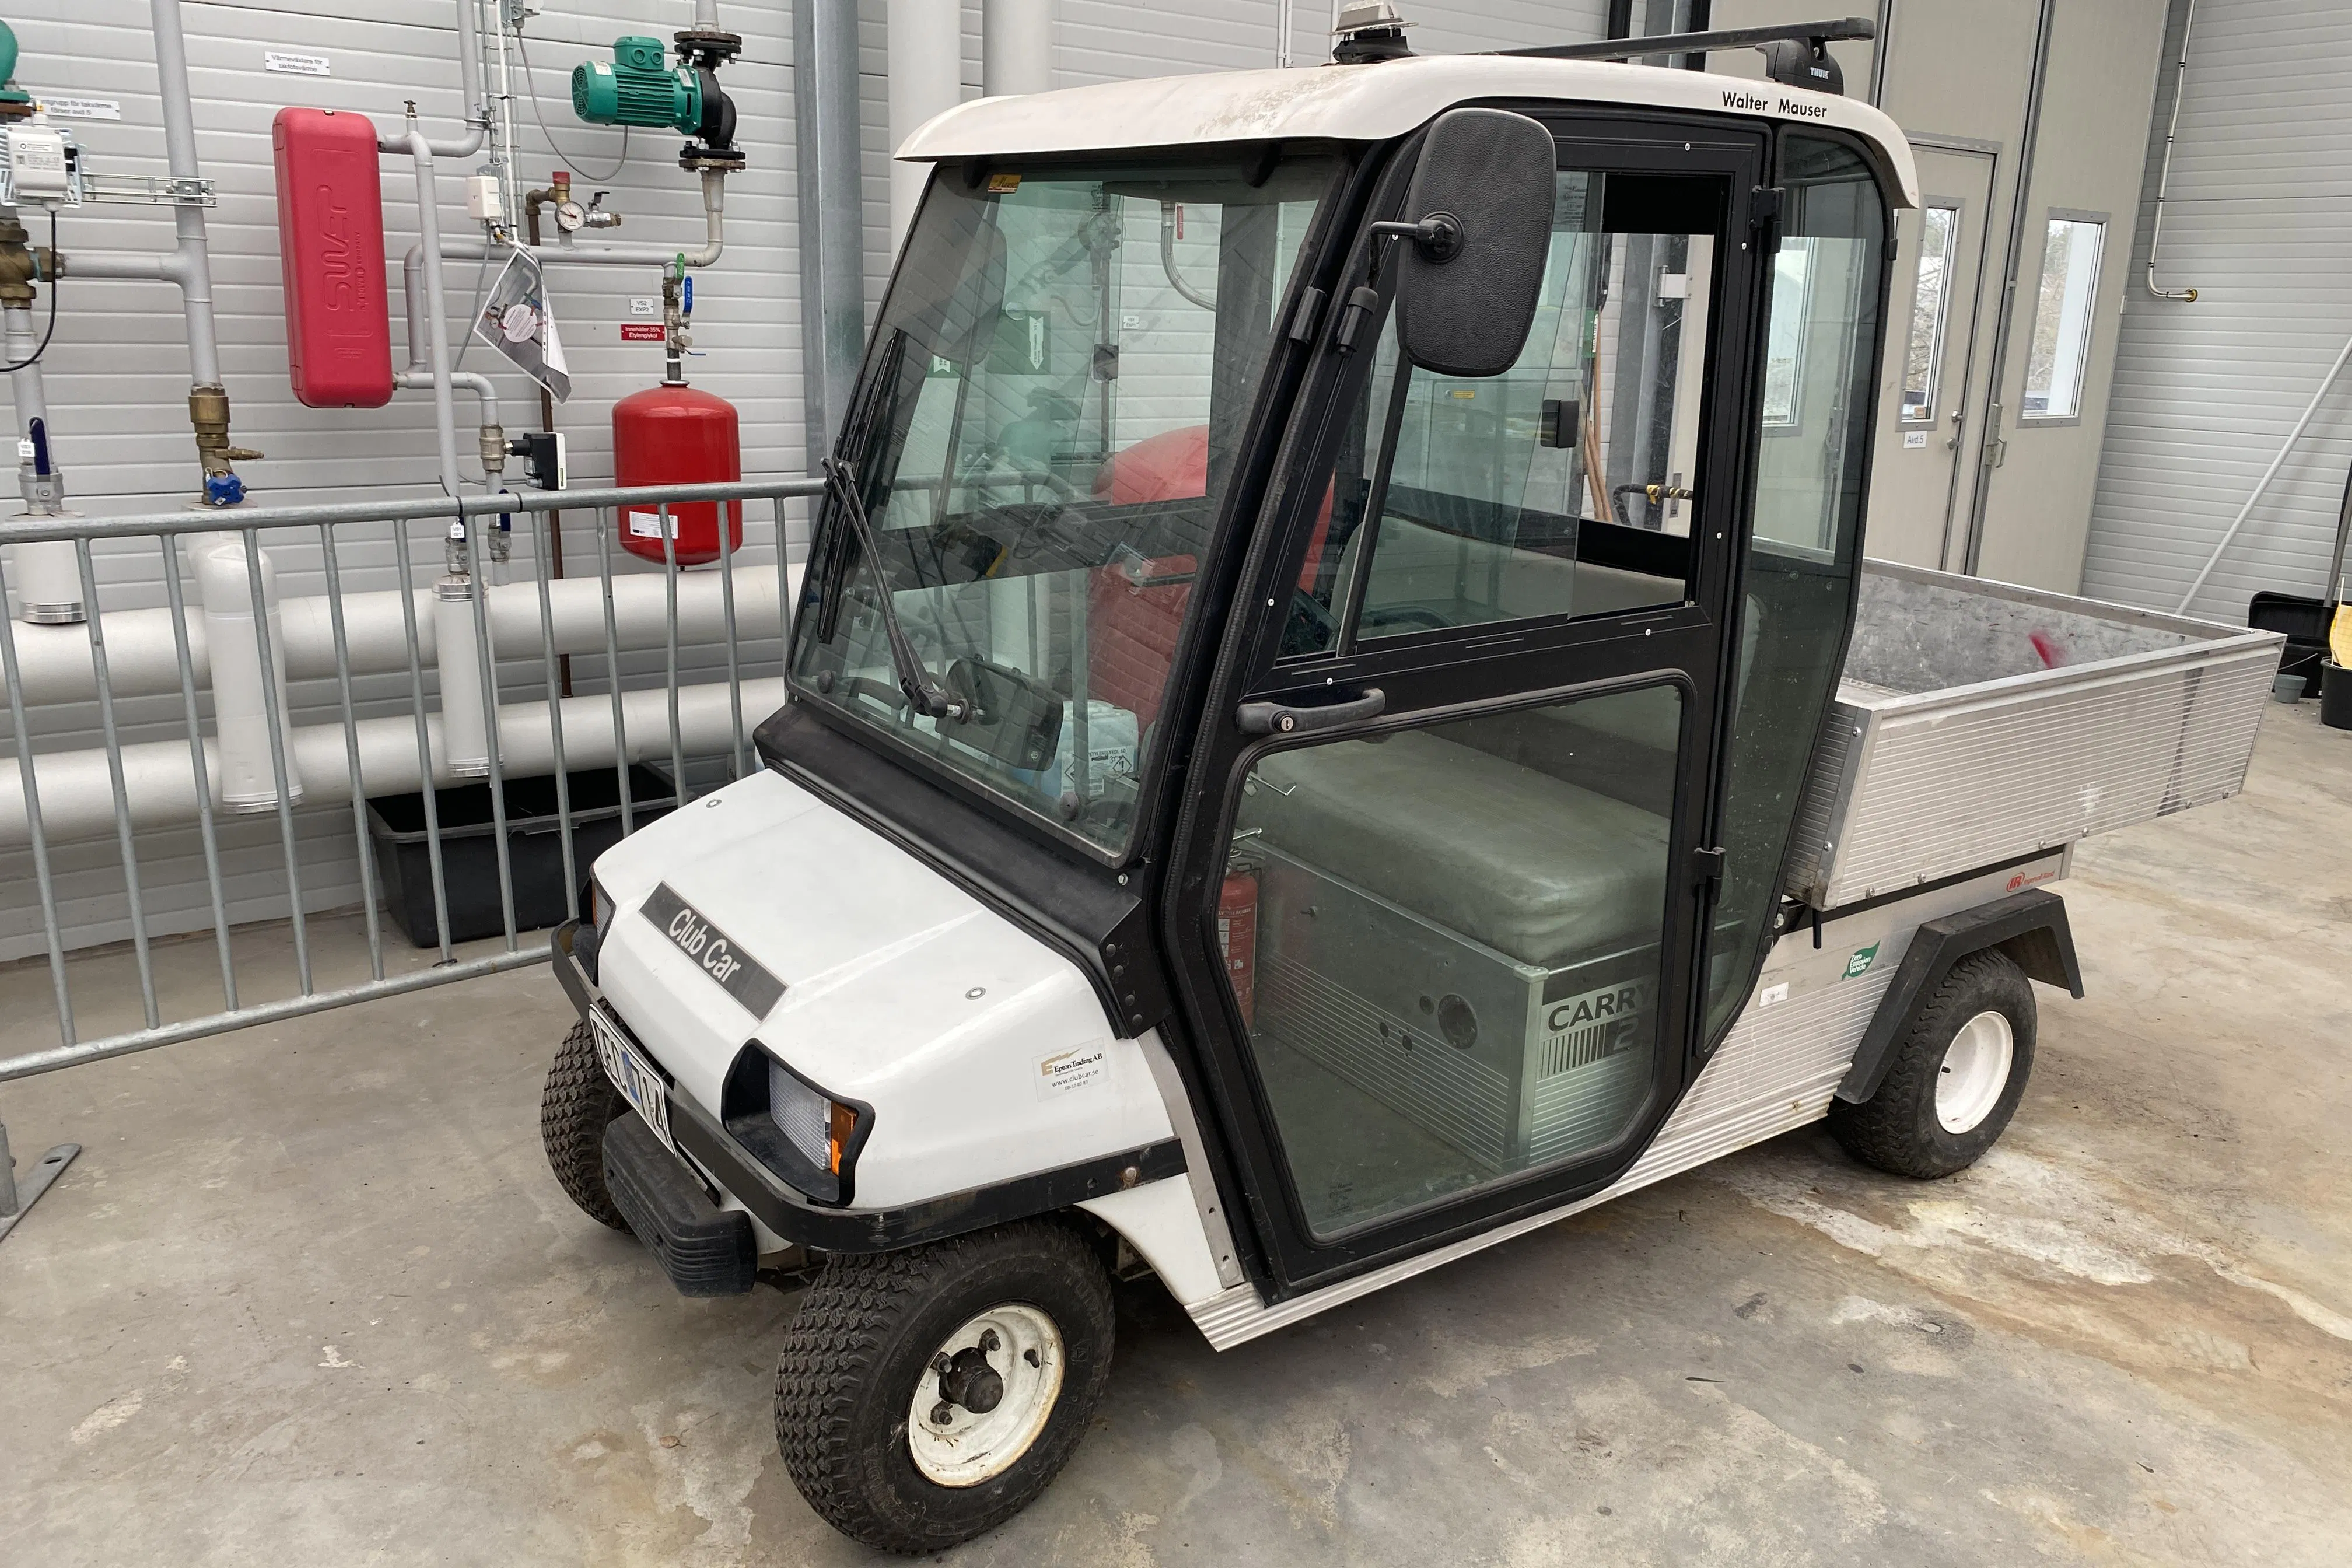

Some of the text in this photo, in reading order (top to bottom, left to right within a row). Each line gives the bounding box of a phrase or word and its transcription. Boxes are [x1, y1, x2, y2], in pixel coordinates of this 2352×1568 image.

[1810, 66, 1830, 79] THULE
[1722, 90, 1827, 118] Walter Mauser
[668, 908, 741, 982] Club Car
[1850, 957, 1871, 968] Emission
[1851, 953, 1863, 963] Zero
[1849, 964, 1866, 974] Vehicle
[1548, 979, 1655, 1032] CARRY
[1612, 1015, 1639, 1051] 2
[1054, 1064, 1072, 1073] Epton
[1071, 1056, 1093, 1068] Trading
[1093, 1053, 1102, 1062] AB
[1051, 1069, 1099, 1088] www.clubcar.se
